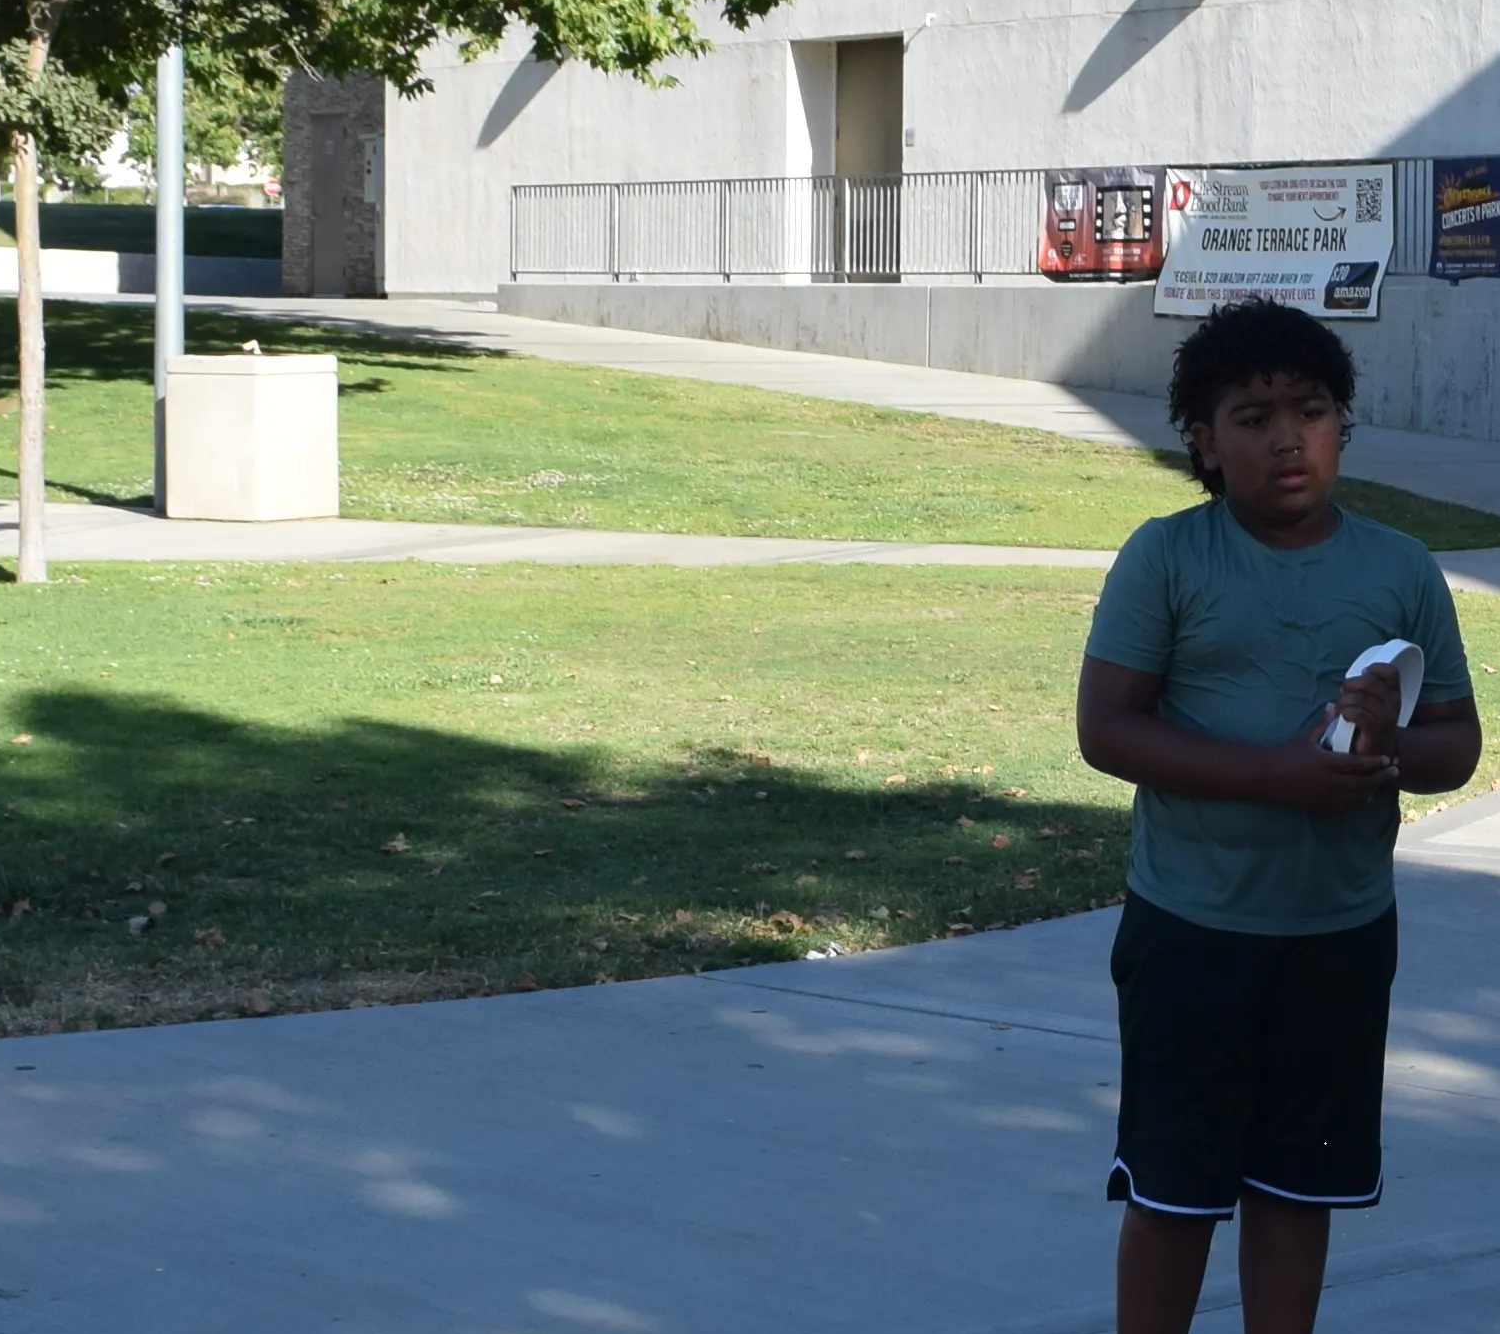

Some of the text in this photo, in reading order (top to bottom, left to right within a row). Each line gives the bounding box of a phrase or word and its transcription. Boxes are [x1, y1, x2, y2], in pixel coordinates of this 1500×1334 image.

[1191, 195, 1248, 213] Blood Bank
[1442, 206, 1475, 229] CONCERTS
[1201, 227, 1348, 252] ORANGE TERRACE PARK
[1173, 271, 1197, 283] ECEIVE
[1203, 271, 1219, 284] $20
[1219, 271, 1245, 284] AMAZON
[1246, 272, 1260, 284] GIFT
[1261, 272, 1278, 284] CARD
[1279, 272, 1299, 284] WHEN
[1299, 272, 1314, 284] YOU
[1331, 264, 1350, 282] $20
[1186, 287, 1206, 300] BLOOD
[1207, 288, 1221, 300] THIS
[1297, 288, 1316, 301] LIVES
[1334, 286, 1371, 299] amazon
